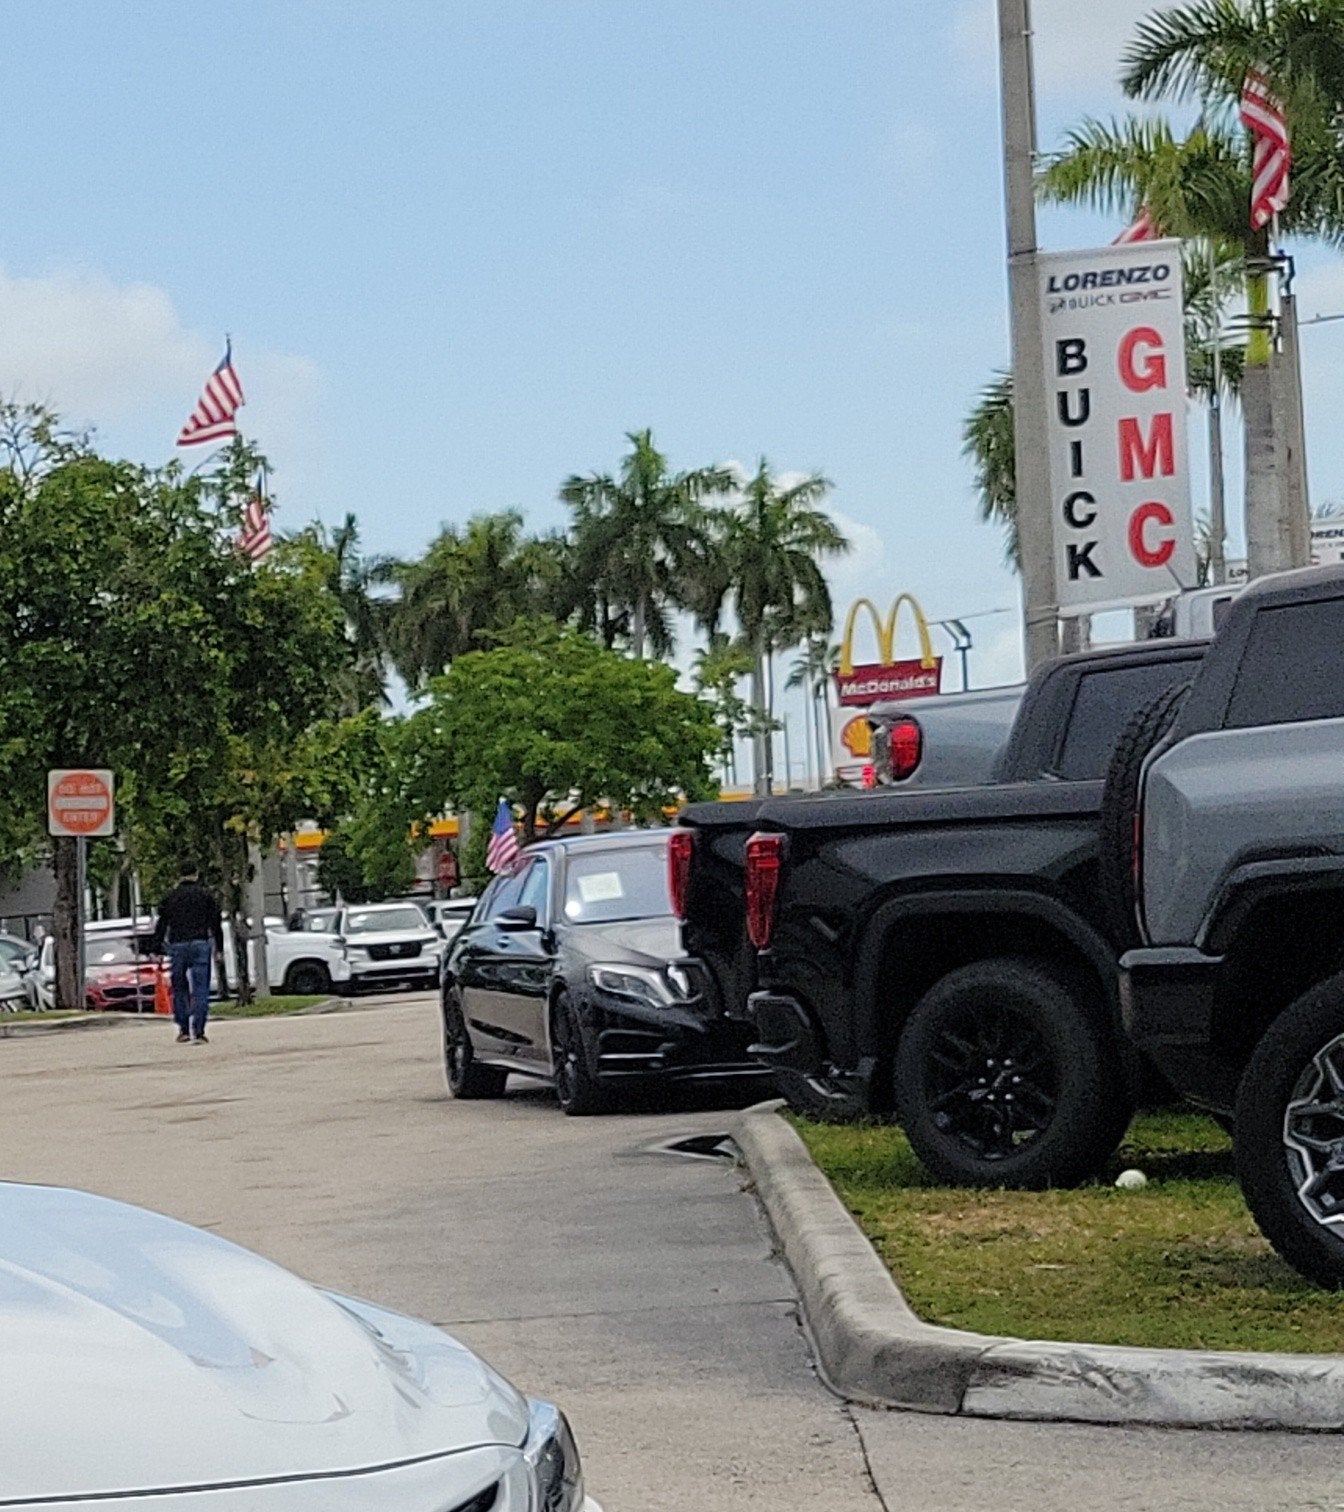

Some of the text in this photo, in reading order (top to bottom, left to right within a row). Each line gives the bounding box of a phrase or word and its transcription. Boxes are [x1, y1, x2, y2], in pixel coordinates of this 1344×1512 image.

[1047, 264, 1171, 293] LORENZO
[1067, 294, 1116, 310] BUICK
[1055, 337, 1104, 582] BUICK
[1117, 326, 1176, 569] GMC
[841, 675, 937, 696] McDonald's
